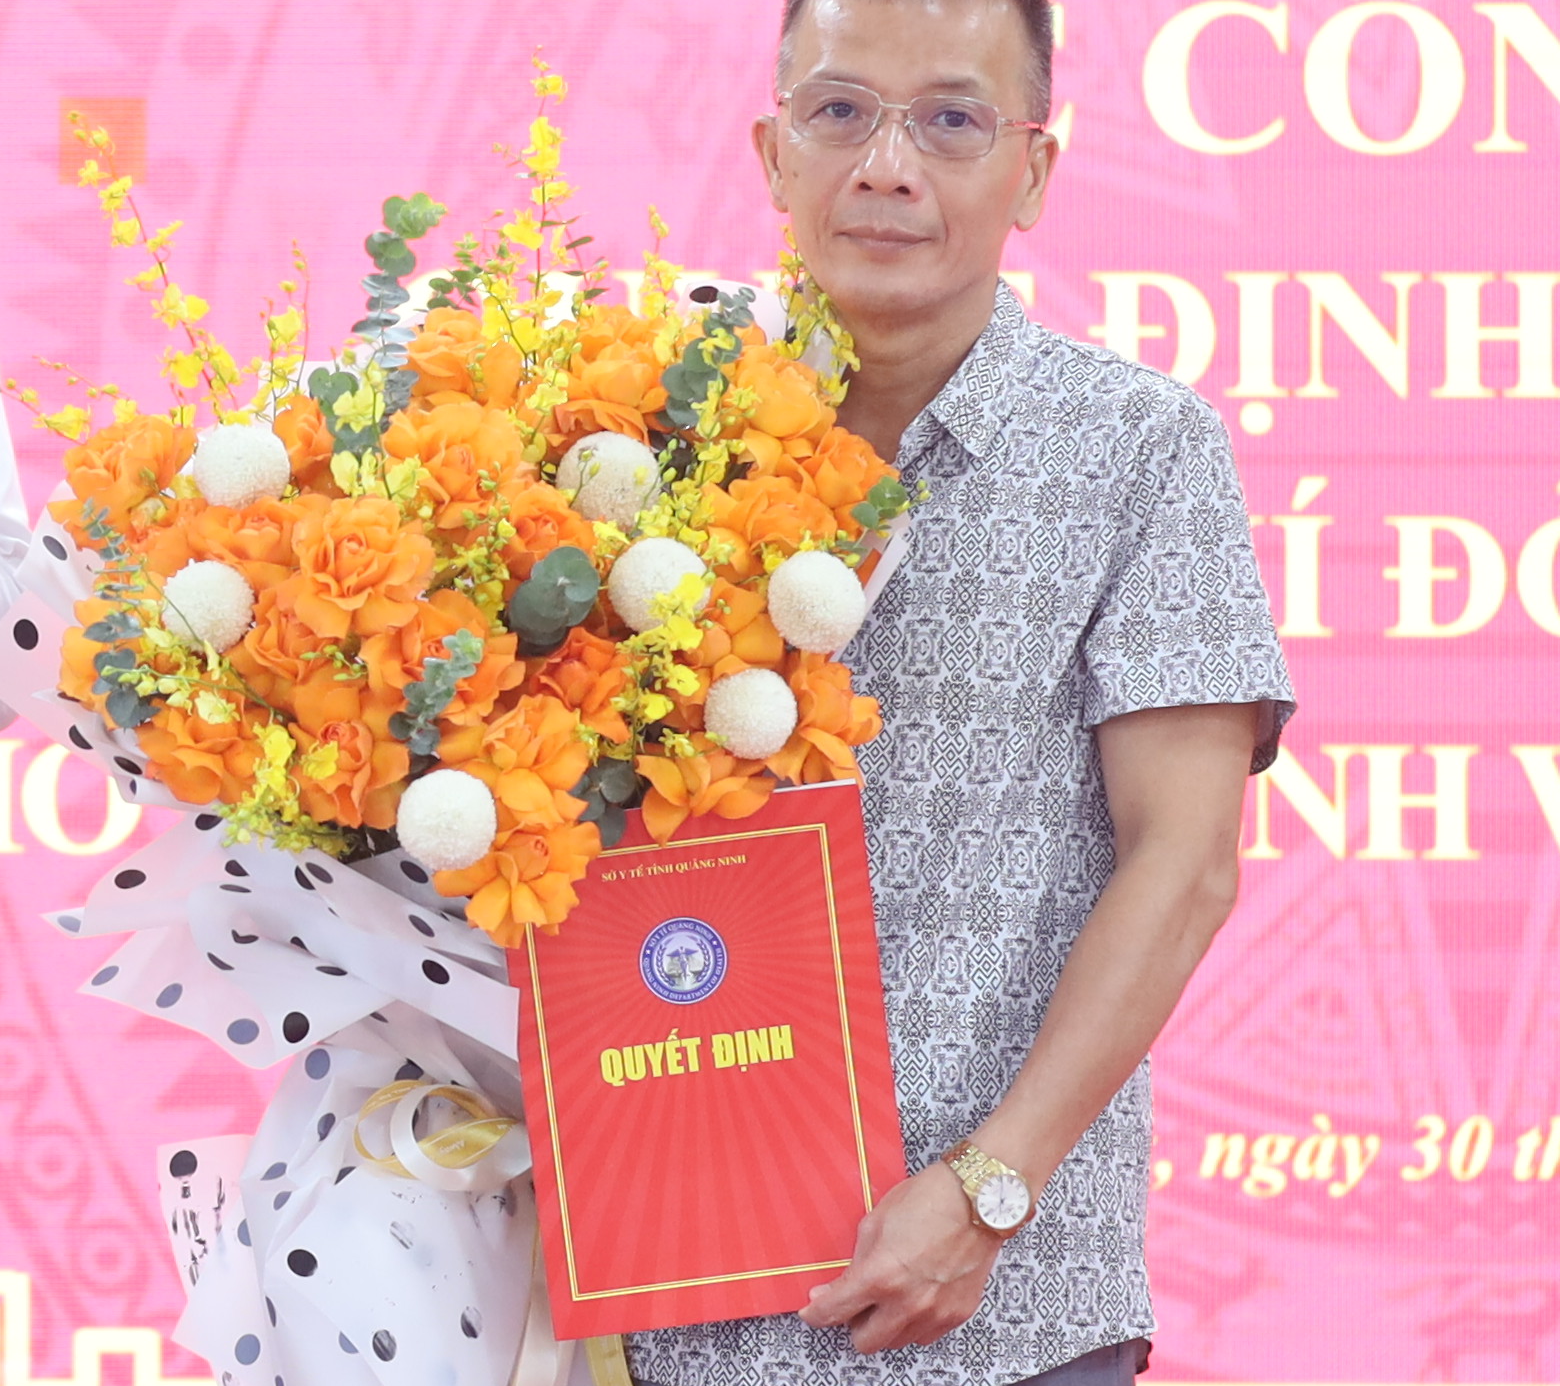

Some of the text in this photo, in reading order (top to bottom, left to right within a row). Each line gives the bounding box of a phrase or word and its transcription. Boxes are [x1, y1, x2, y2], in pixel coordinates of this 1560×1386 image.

[1242, 743, 1481, 861] NH
[618, 869, 626, 880] Y
[718, 854, 747, 867] NINH
[600, 1024, 795, 1087] QUYẾT ĐỊNH
[1198, 1113, 1381, 1199] ngày
[1400, 1114, 1494, 1182] 30
